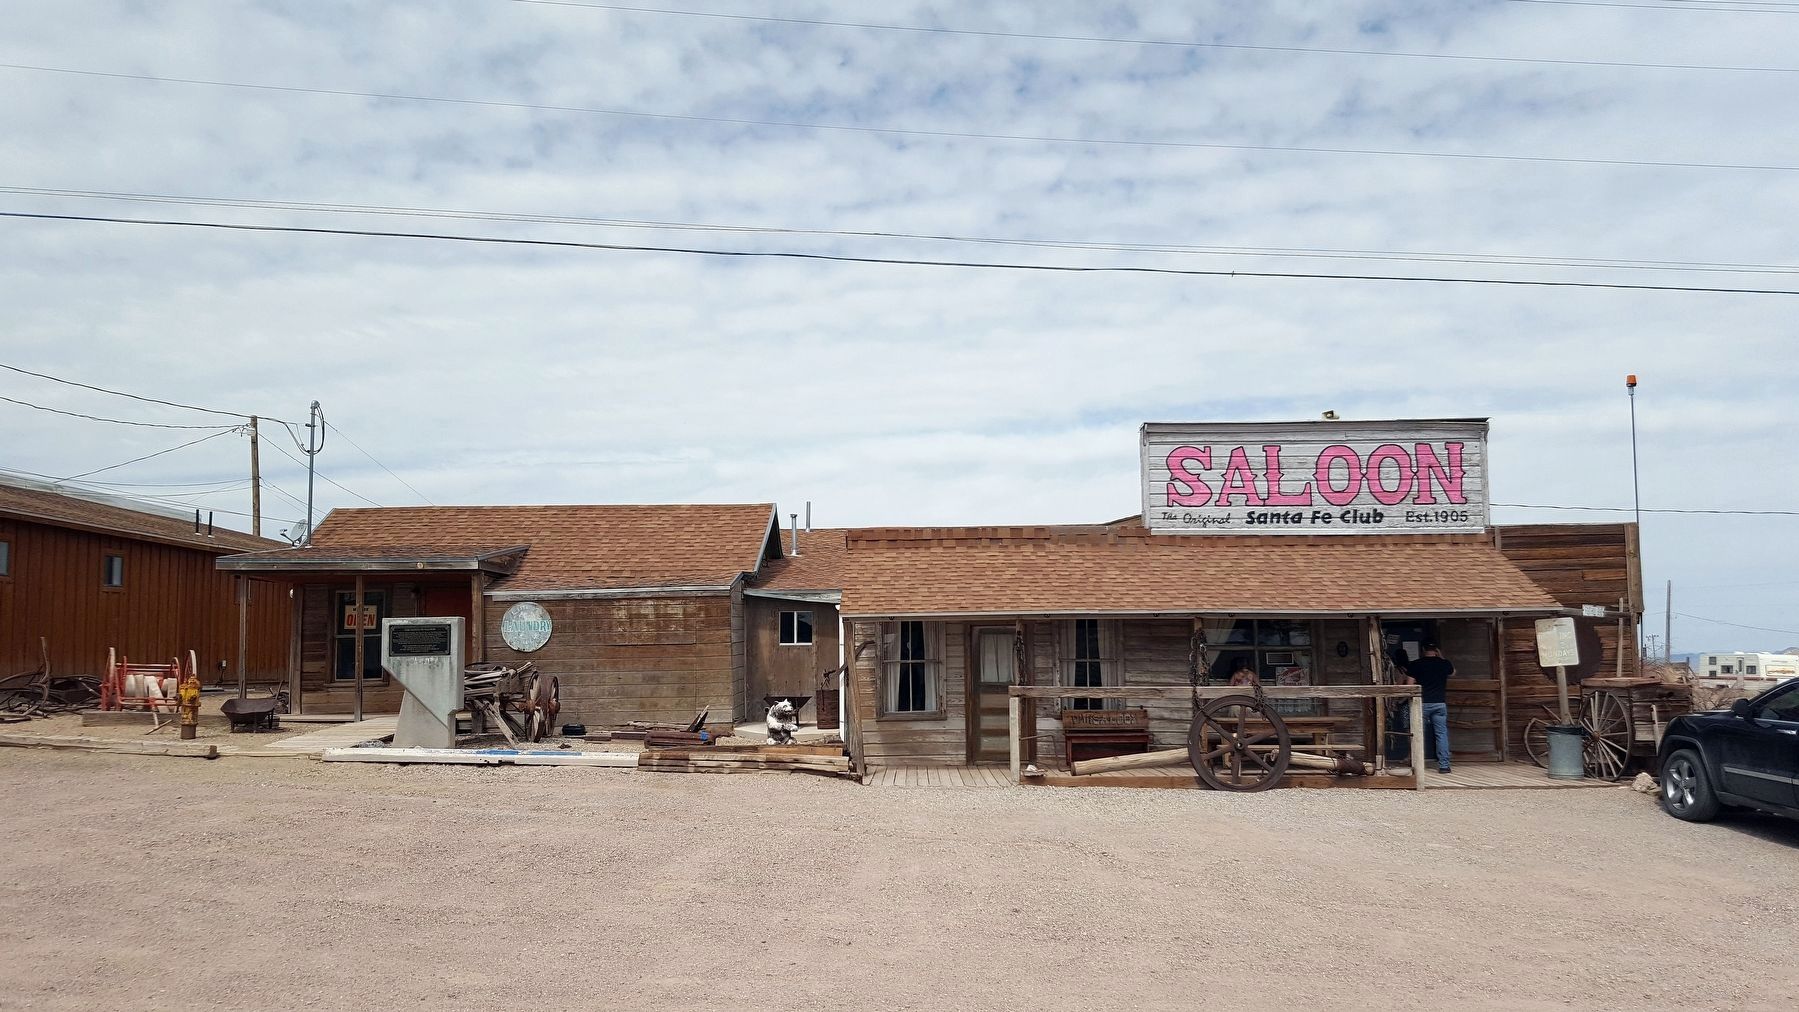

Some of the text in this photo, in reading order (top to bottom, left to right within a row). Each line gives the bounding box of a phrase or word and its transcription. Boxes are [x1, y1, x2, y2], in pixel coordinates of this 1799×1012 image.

[1166, 442, 1467, 507] SALOON
[1183, 512, 1231, 528] Original
[1245, 510, 1303, 525] Santa
[1310, 510, 1332, 524] Fe
[1340, 508, 1384, 524] Club
[346, 613, 376, 627] OEN
[503, 620, 552, 633] LAUNDRY
